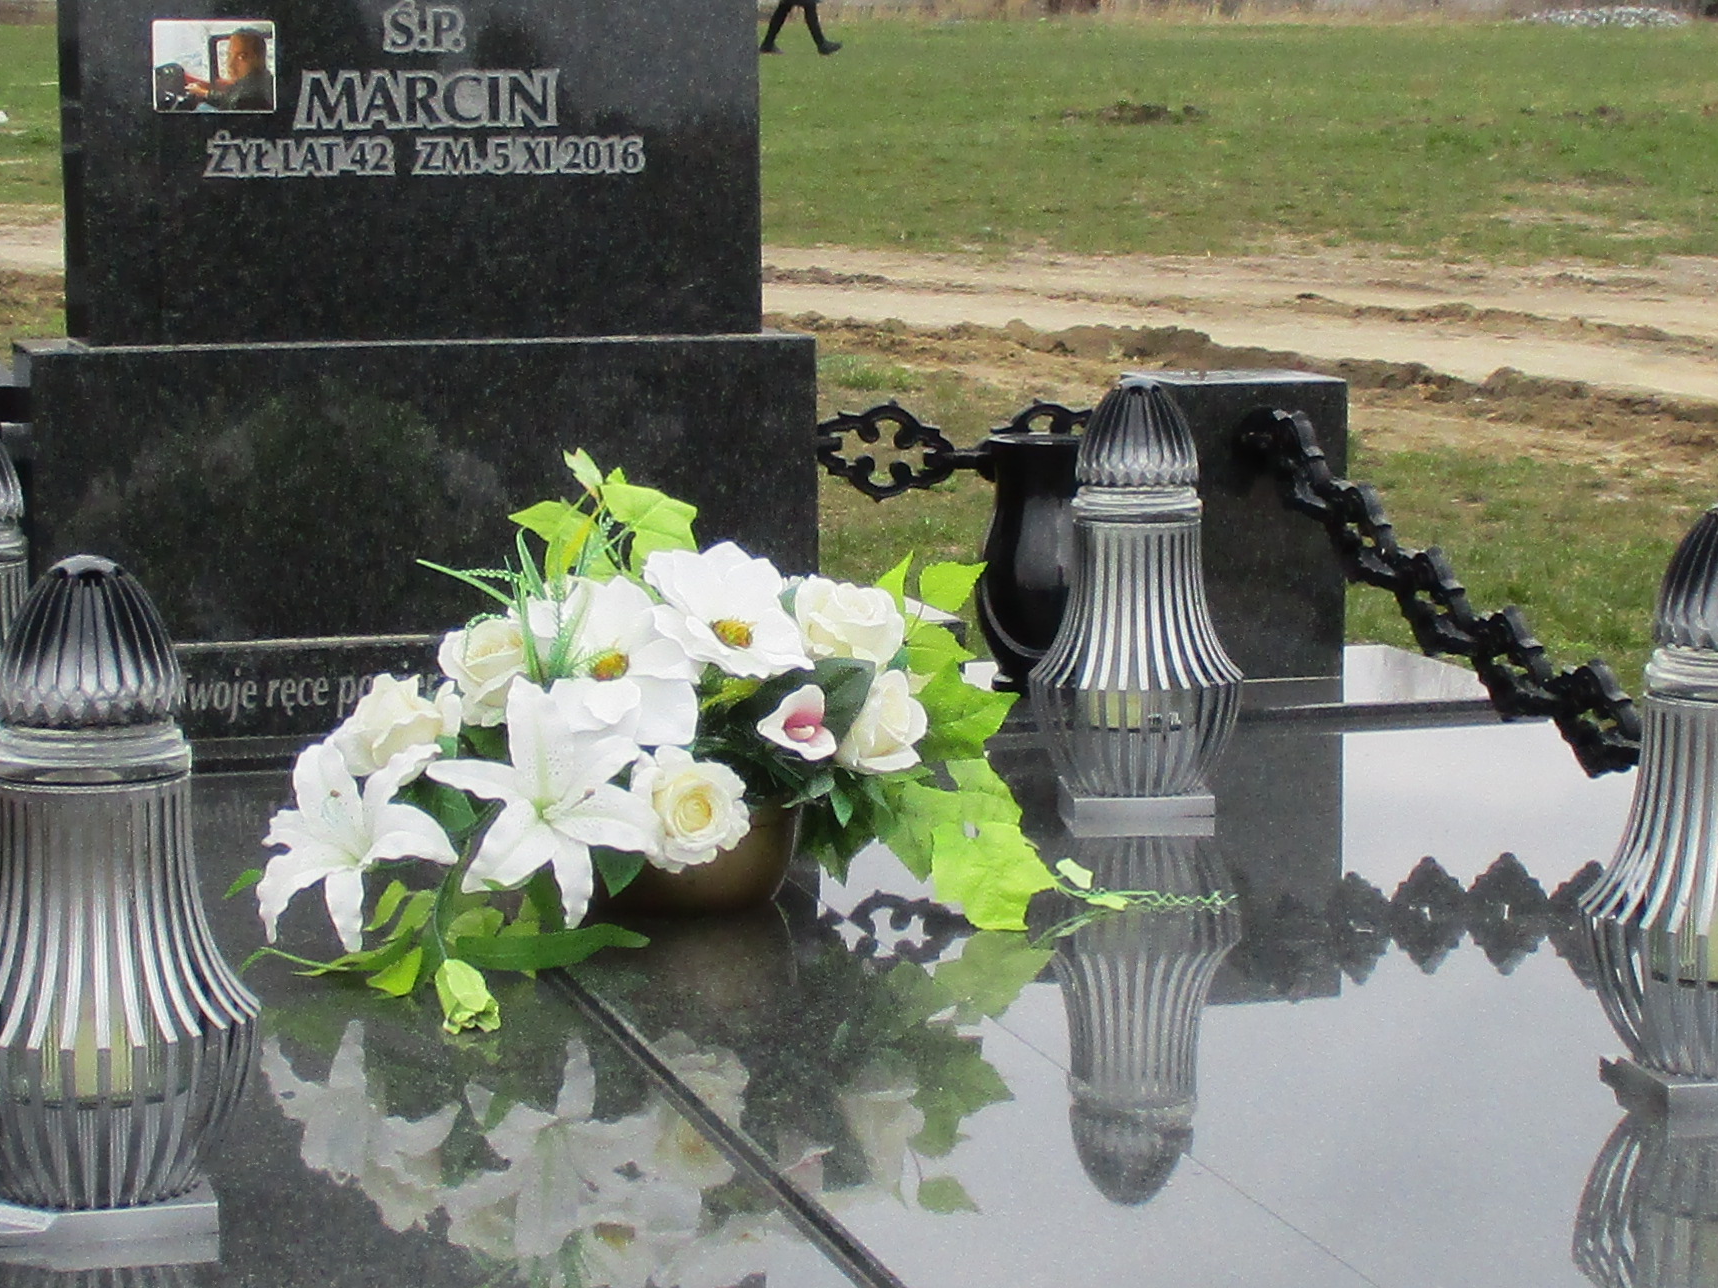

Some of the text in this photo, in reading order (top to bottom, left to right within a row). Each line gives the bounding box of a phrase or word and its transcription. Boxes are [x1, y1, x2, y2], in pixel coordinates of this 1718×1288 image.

[293, 68, 560, 131] MARCIN
[203, 129, 647, 178] ŻYŁ LAT 42 ZM. 5 XI 2016
[183, 667, 259, 724] woje
[265, 672, 331, 717] ręce
